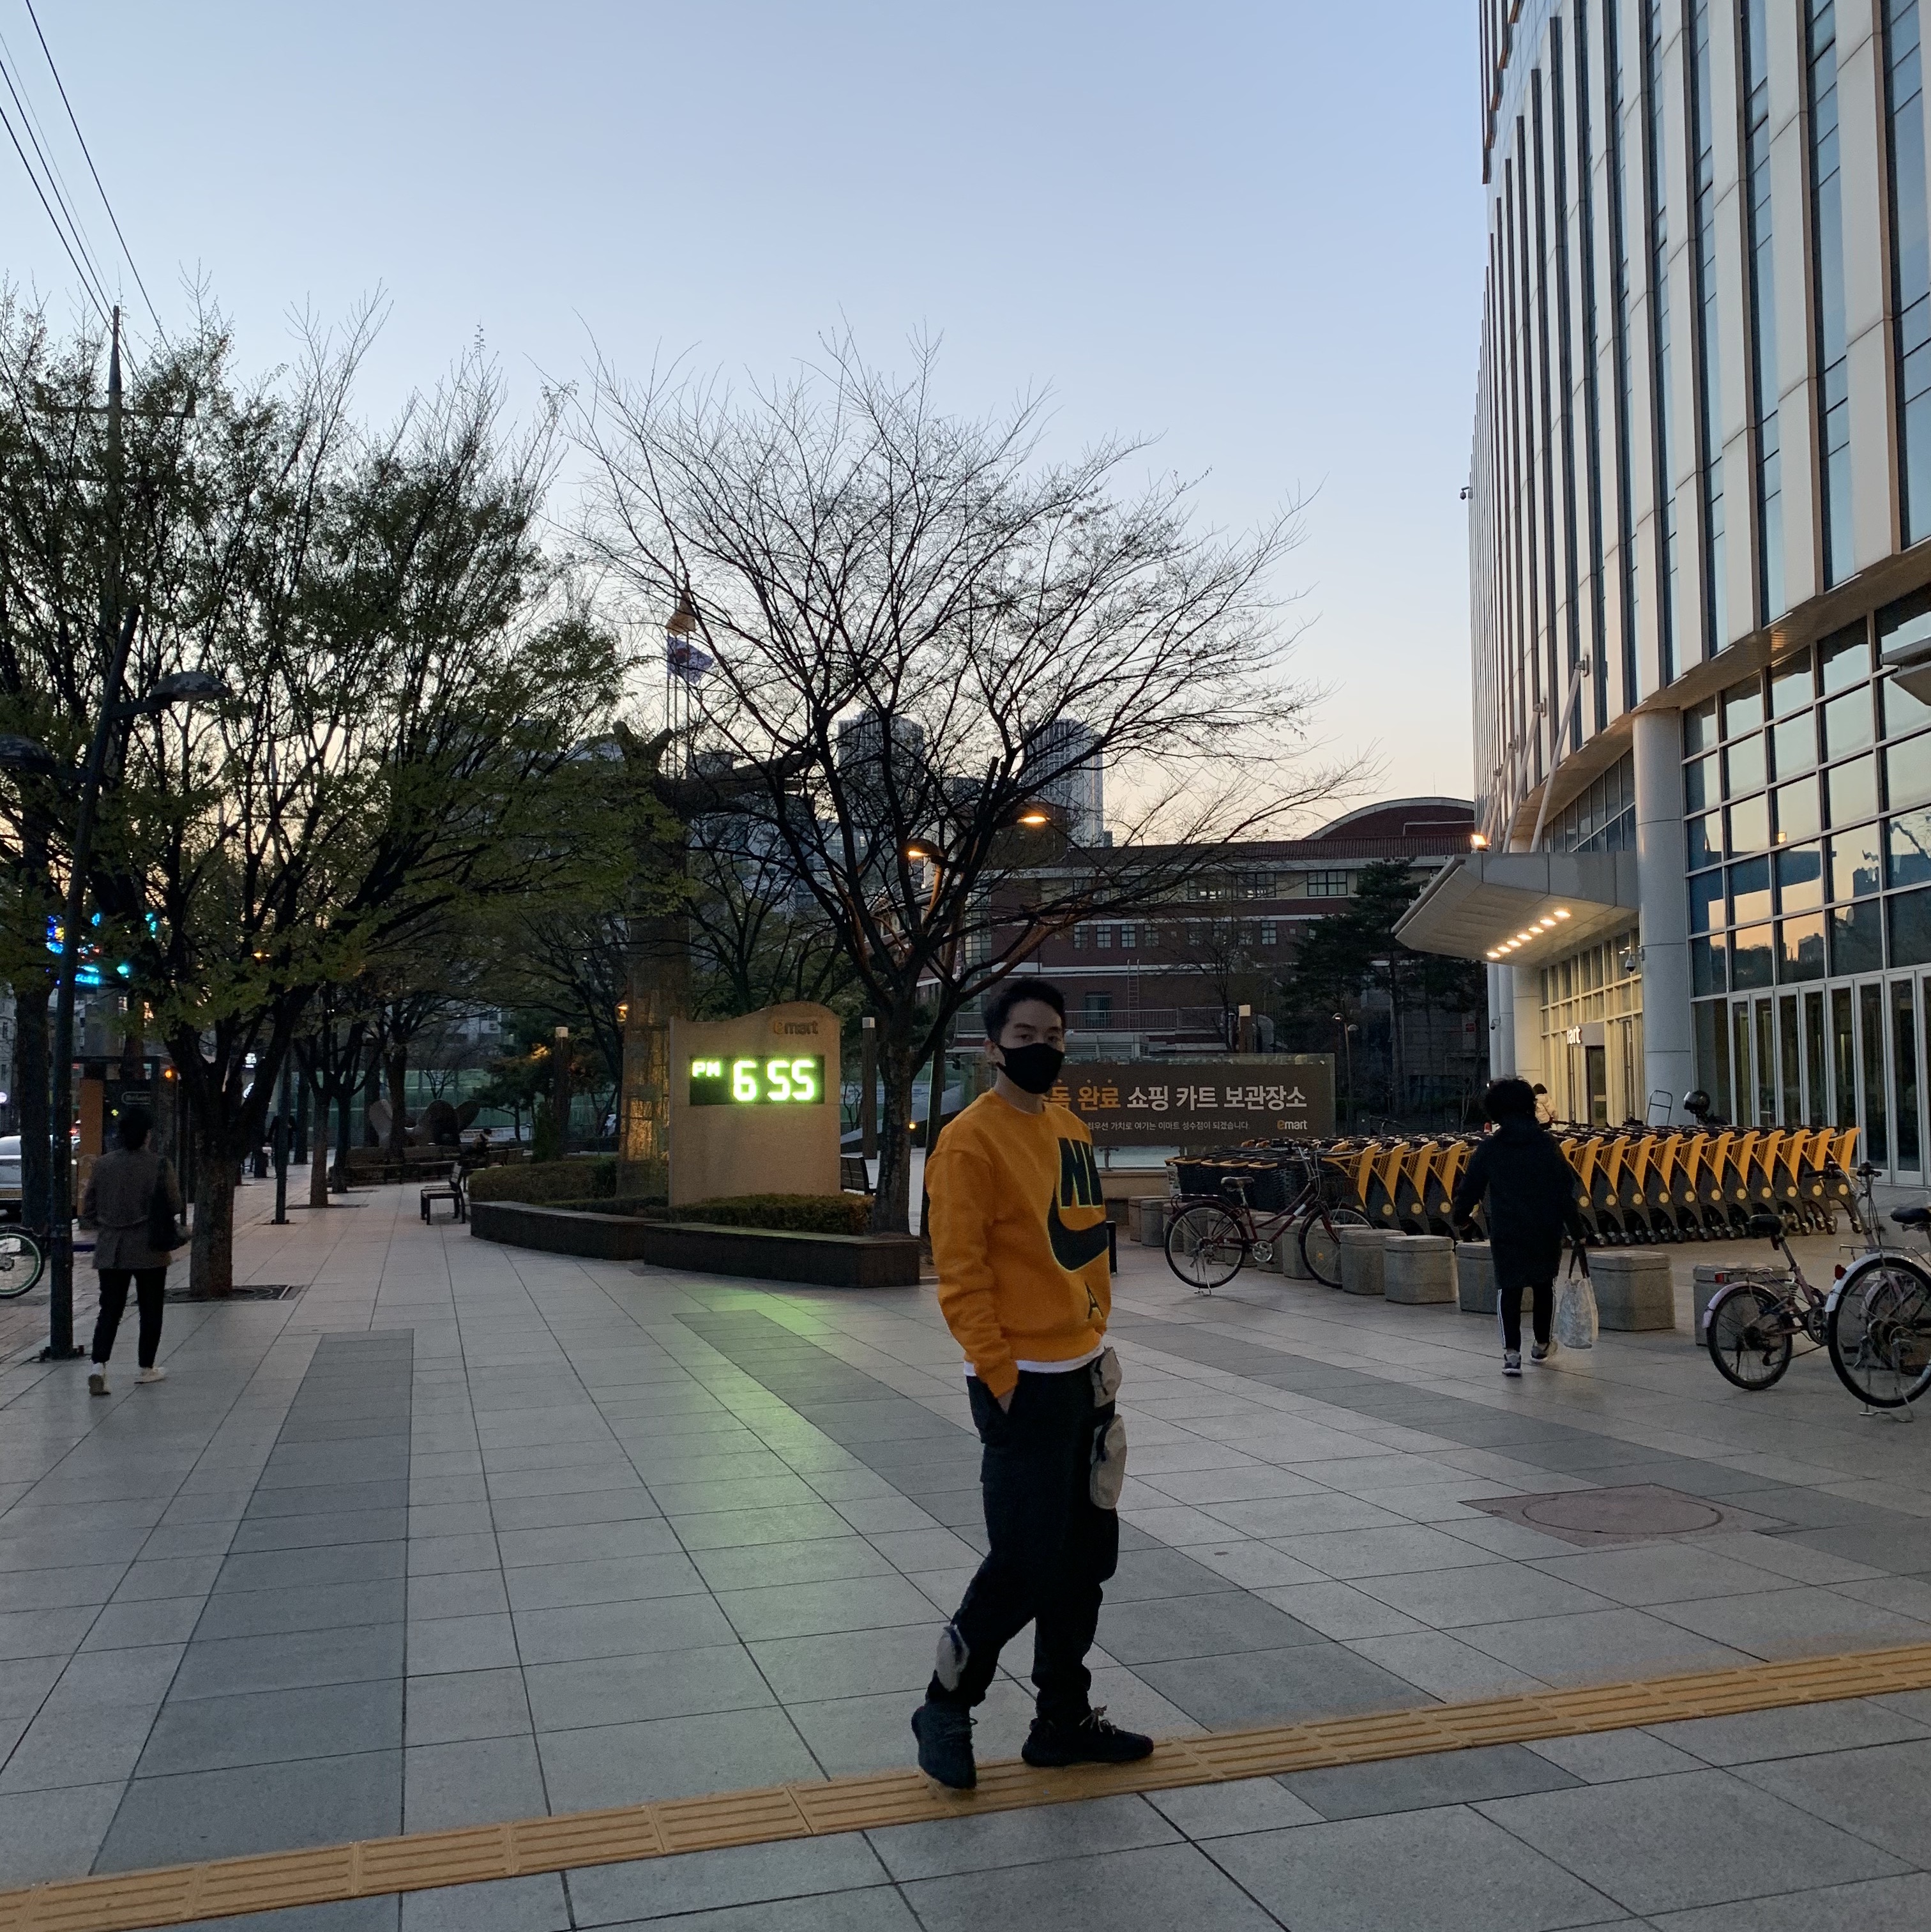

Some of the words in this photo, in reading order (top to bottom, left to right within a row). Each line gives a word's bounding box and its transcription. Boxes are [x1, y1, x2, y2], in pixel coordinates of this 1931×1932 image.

[773, 1021, 819, 1035] emart
[692, 1061, 721, 1077] PM
[1041, 1086, 1072, 1109] 독
[1077, 1086, 1121, 1111] 완료
[1126, 1085, 1169, 1111] 쇼핑
[1176, 1085, 1218, 1111] 카트
[1223, 1085, 1307, 1111] 보관장소
[1111, 1122, 1133, 1130] 가치로
[1134, 1122, 1156, 1130] 여기는
[1158, 1122, 1180, 1130] 이마트
[1182, 1122, 1211, 1130] 성수점이
[1277, 1120, 1308, 1130] emart
[1084, 1281, 1104, 1320] A
